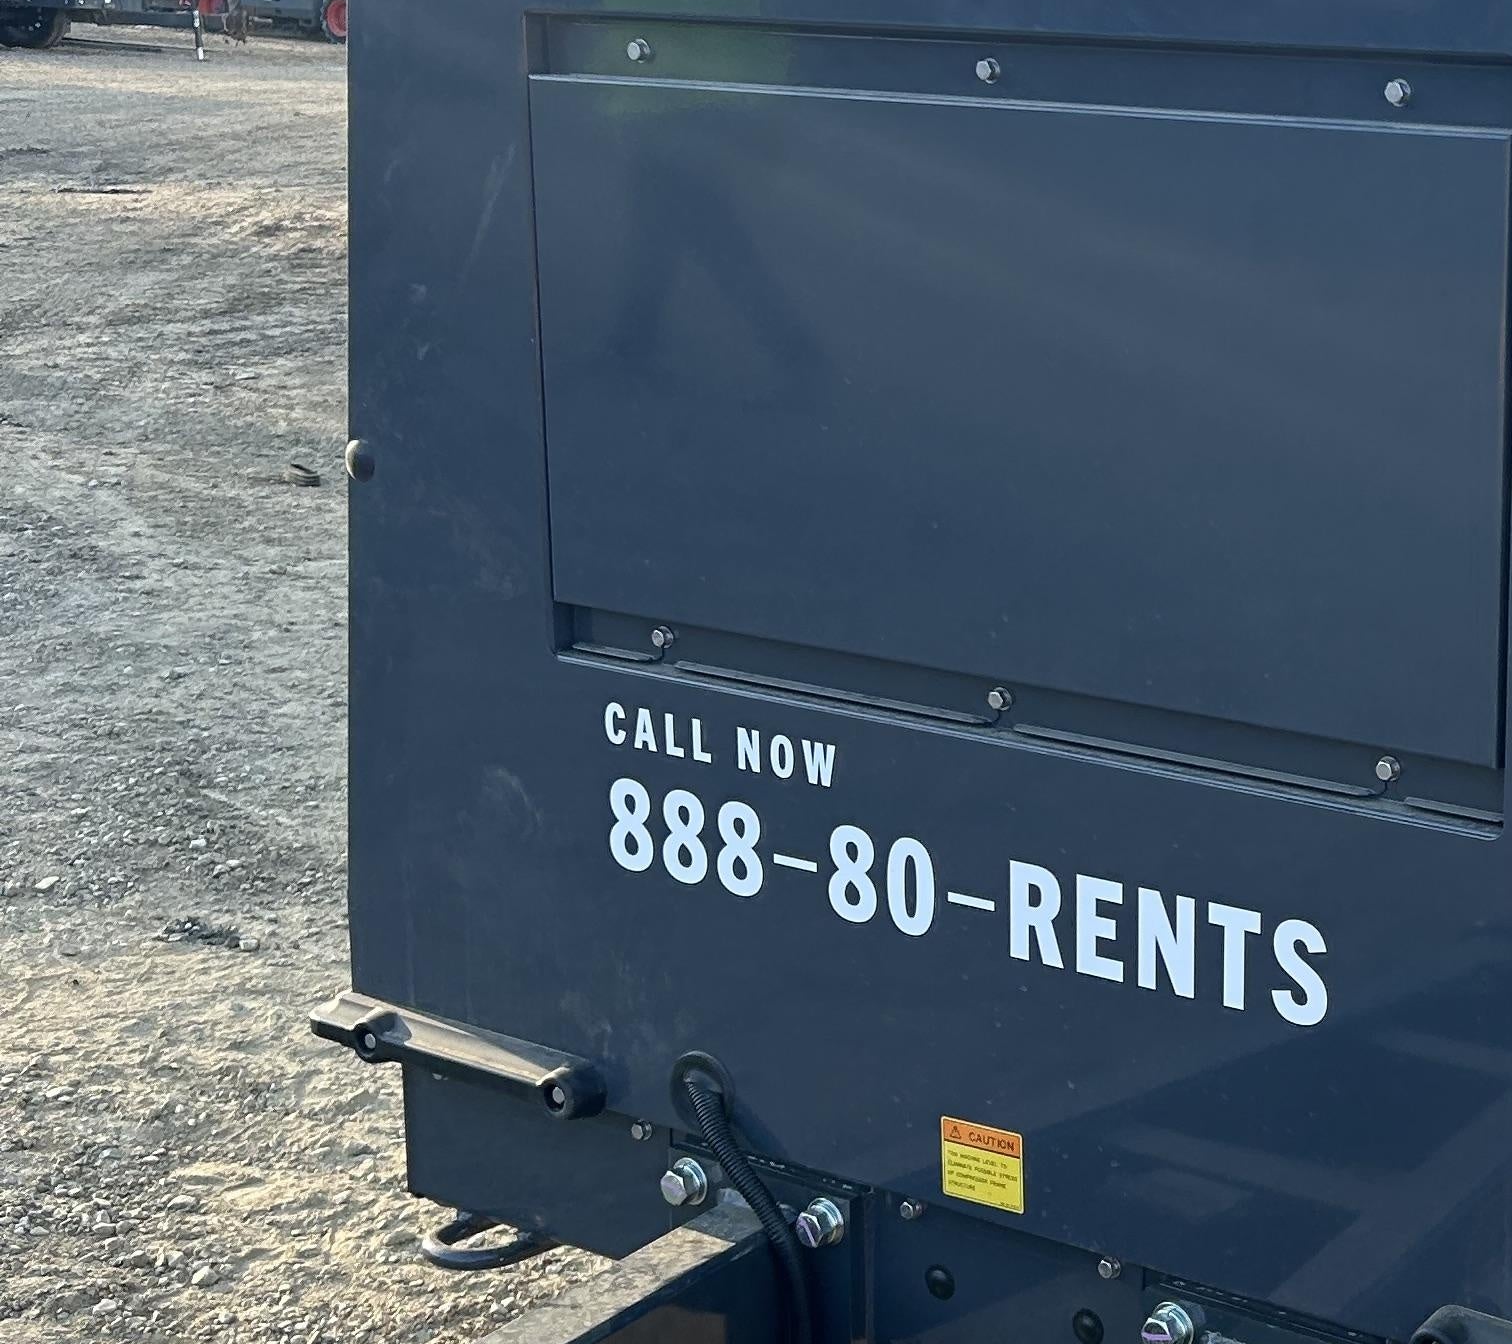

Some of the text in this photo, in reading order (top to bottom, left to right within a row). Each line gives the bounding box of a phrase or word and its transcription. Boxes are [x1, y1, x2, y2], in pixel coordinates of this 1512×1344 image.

[604, 702, 835, 787] CALL NOW
[968, 1131, 1015, 1153] CAUTION
